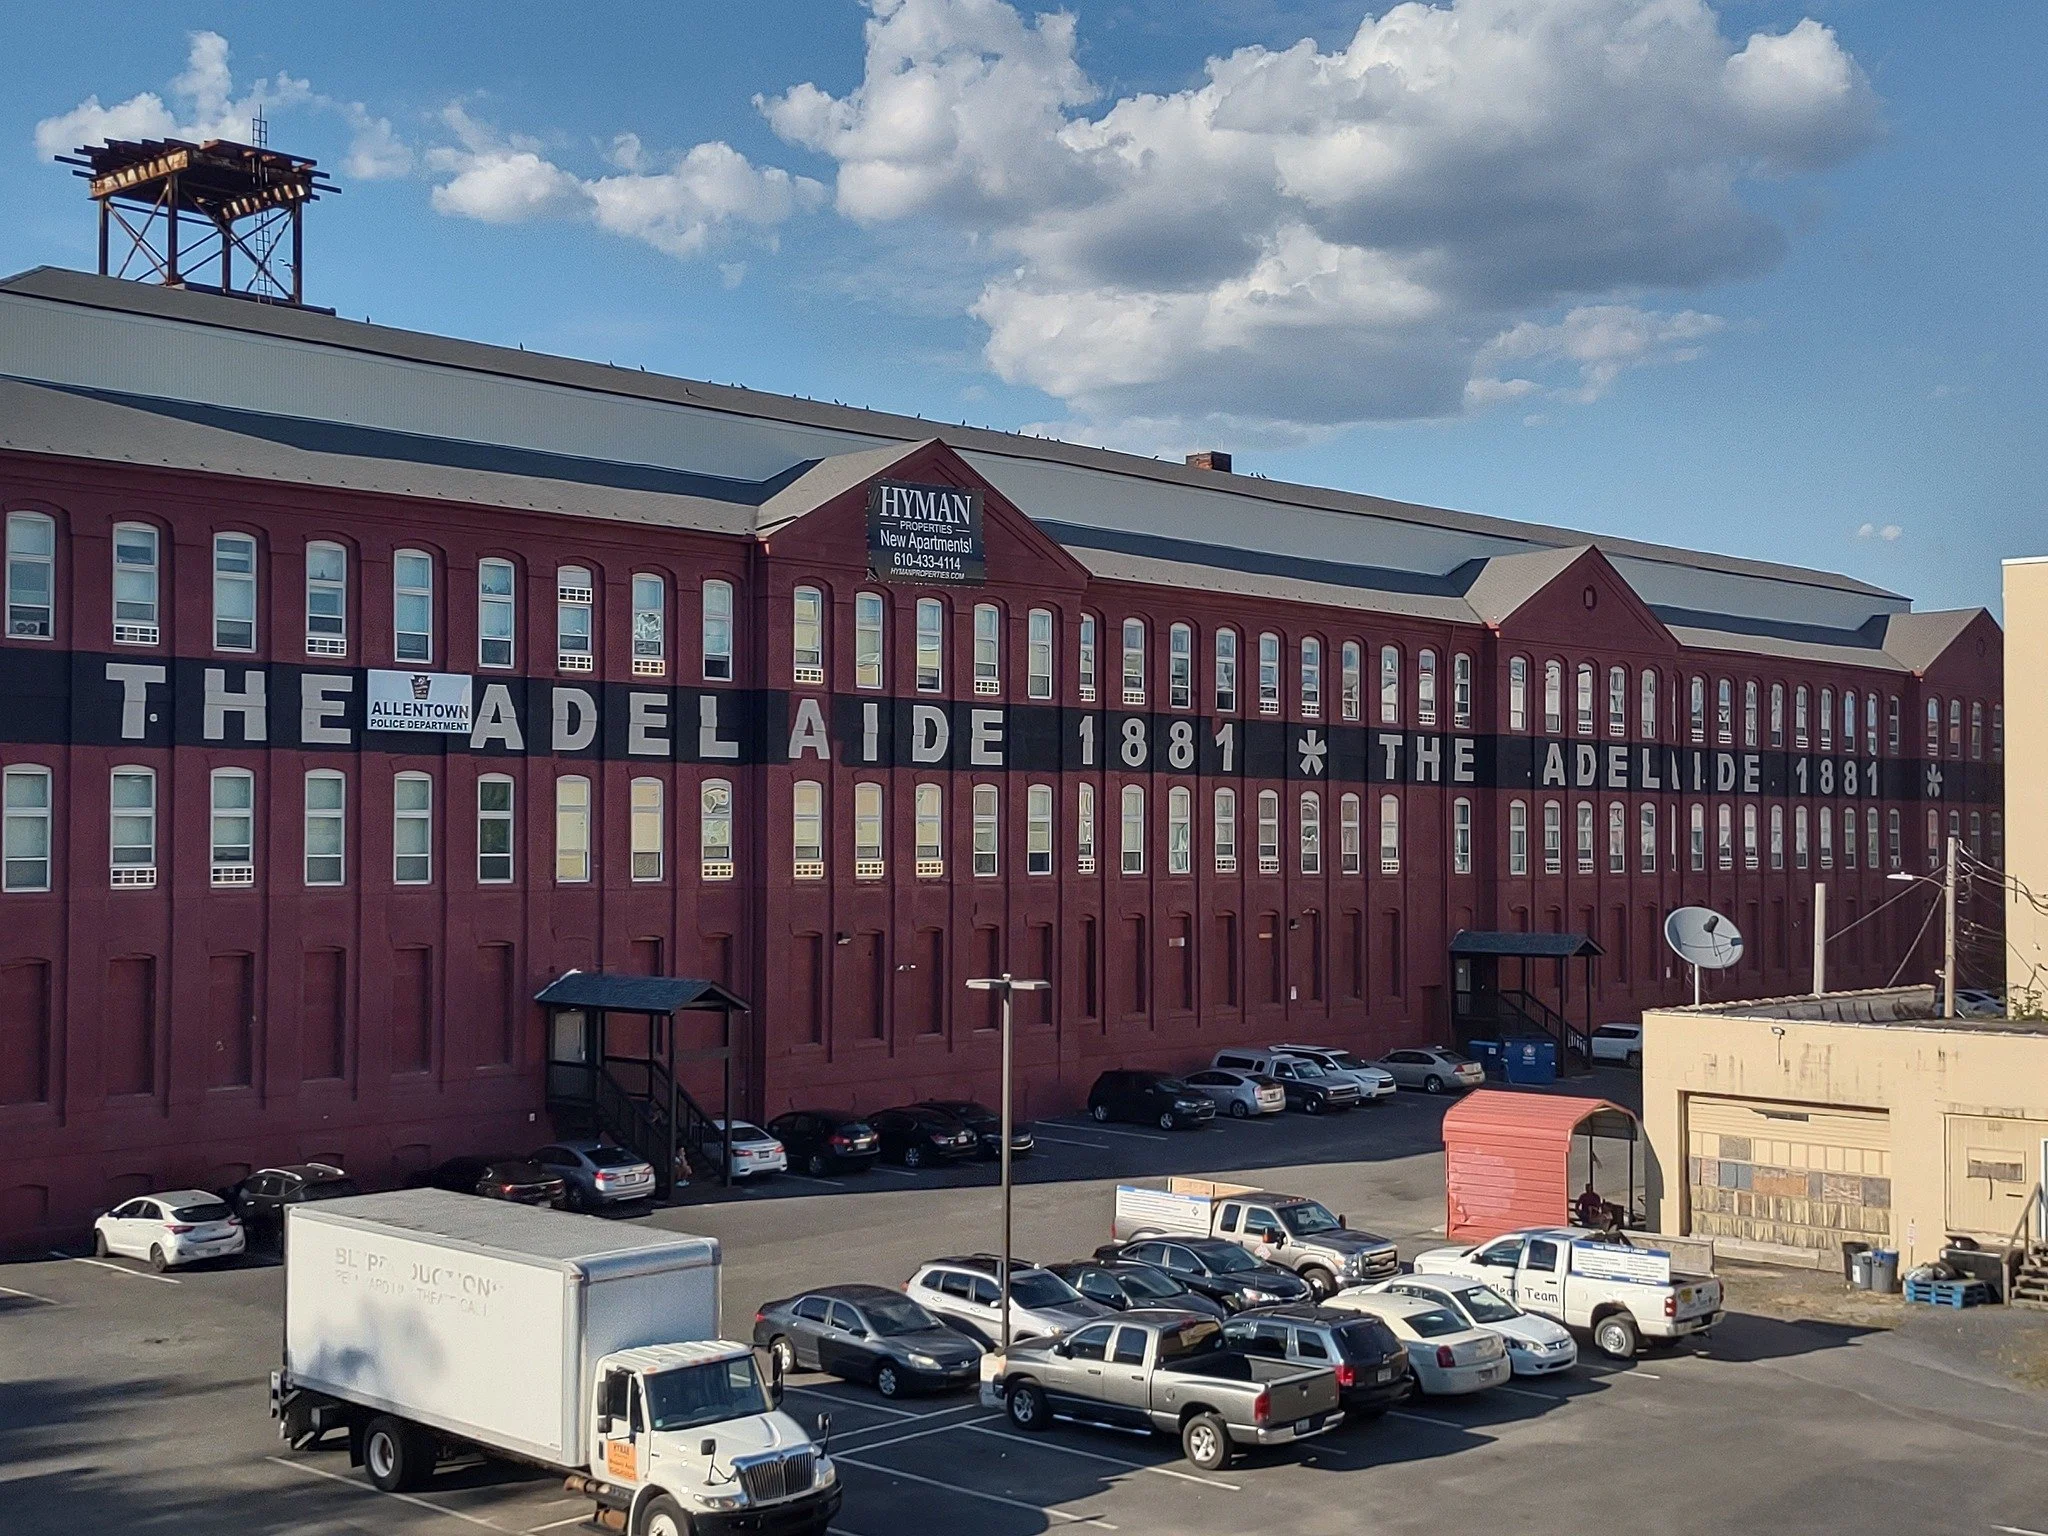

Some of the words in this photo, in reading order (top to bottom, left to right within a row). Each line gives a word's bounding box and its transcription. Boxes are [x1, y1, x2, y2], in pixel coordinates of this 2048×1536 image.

[879, 486, 971, 524] HYMAN
[900, 520, 953, 534] PROPERTIES
[880, 529, 906, 548] New
[908, 532, 973, 554] Apartments!
[894, 552, 961, 570] 610-433-4114
[890, 567, 965, 580] HYMANPROPERTIES.COM
[371, 701, 469, 719] ALLENTOWN
[105, 662, 354, 744] THE
[469, 683, 1004, 766] ADELAIDE
[1079, 715, 1234, 772] 1881
[1379, 734, 1475, 782] THE
[1796, 757, 1879, 797] 1881
[370, 718, 405, 729] POLICE
[407, 720, 469, 731] DEPARTMENT
[1525, 1287, 1558, 1302] Team
